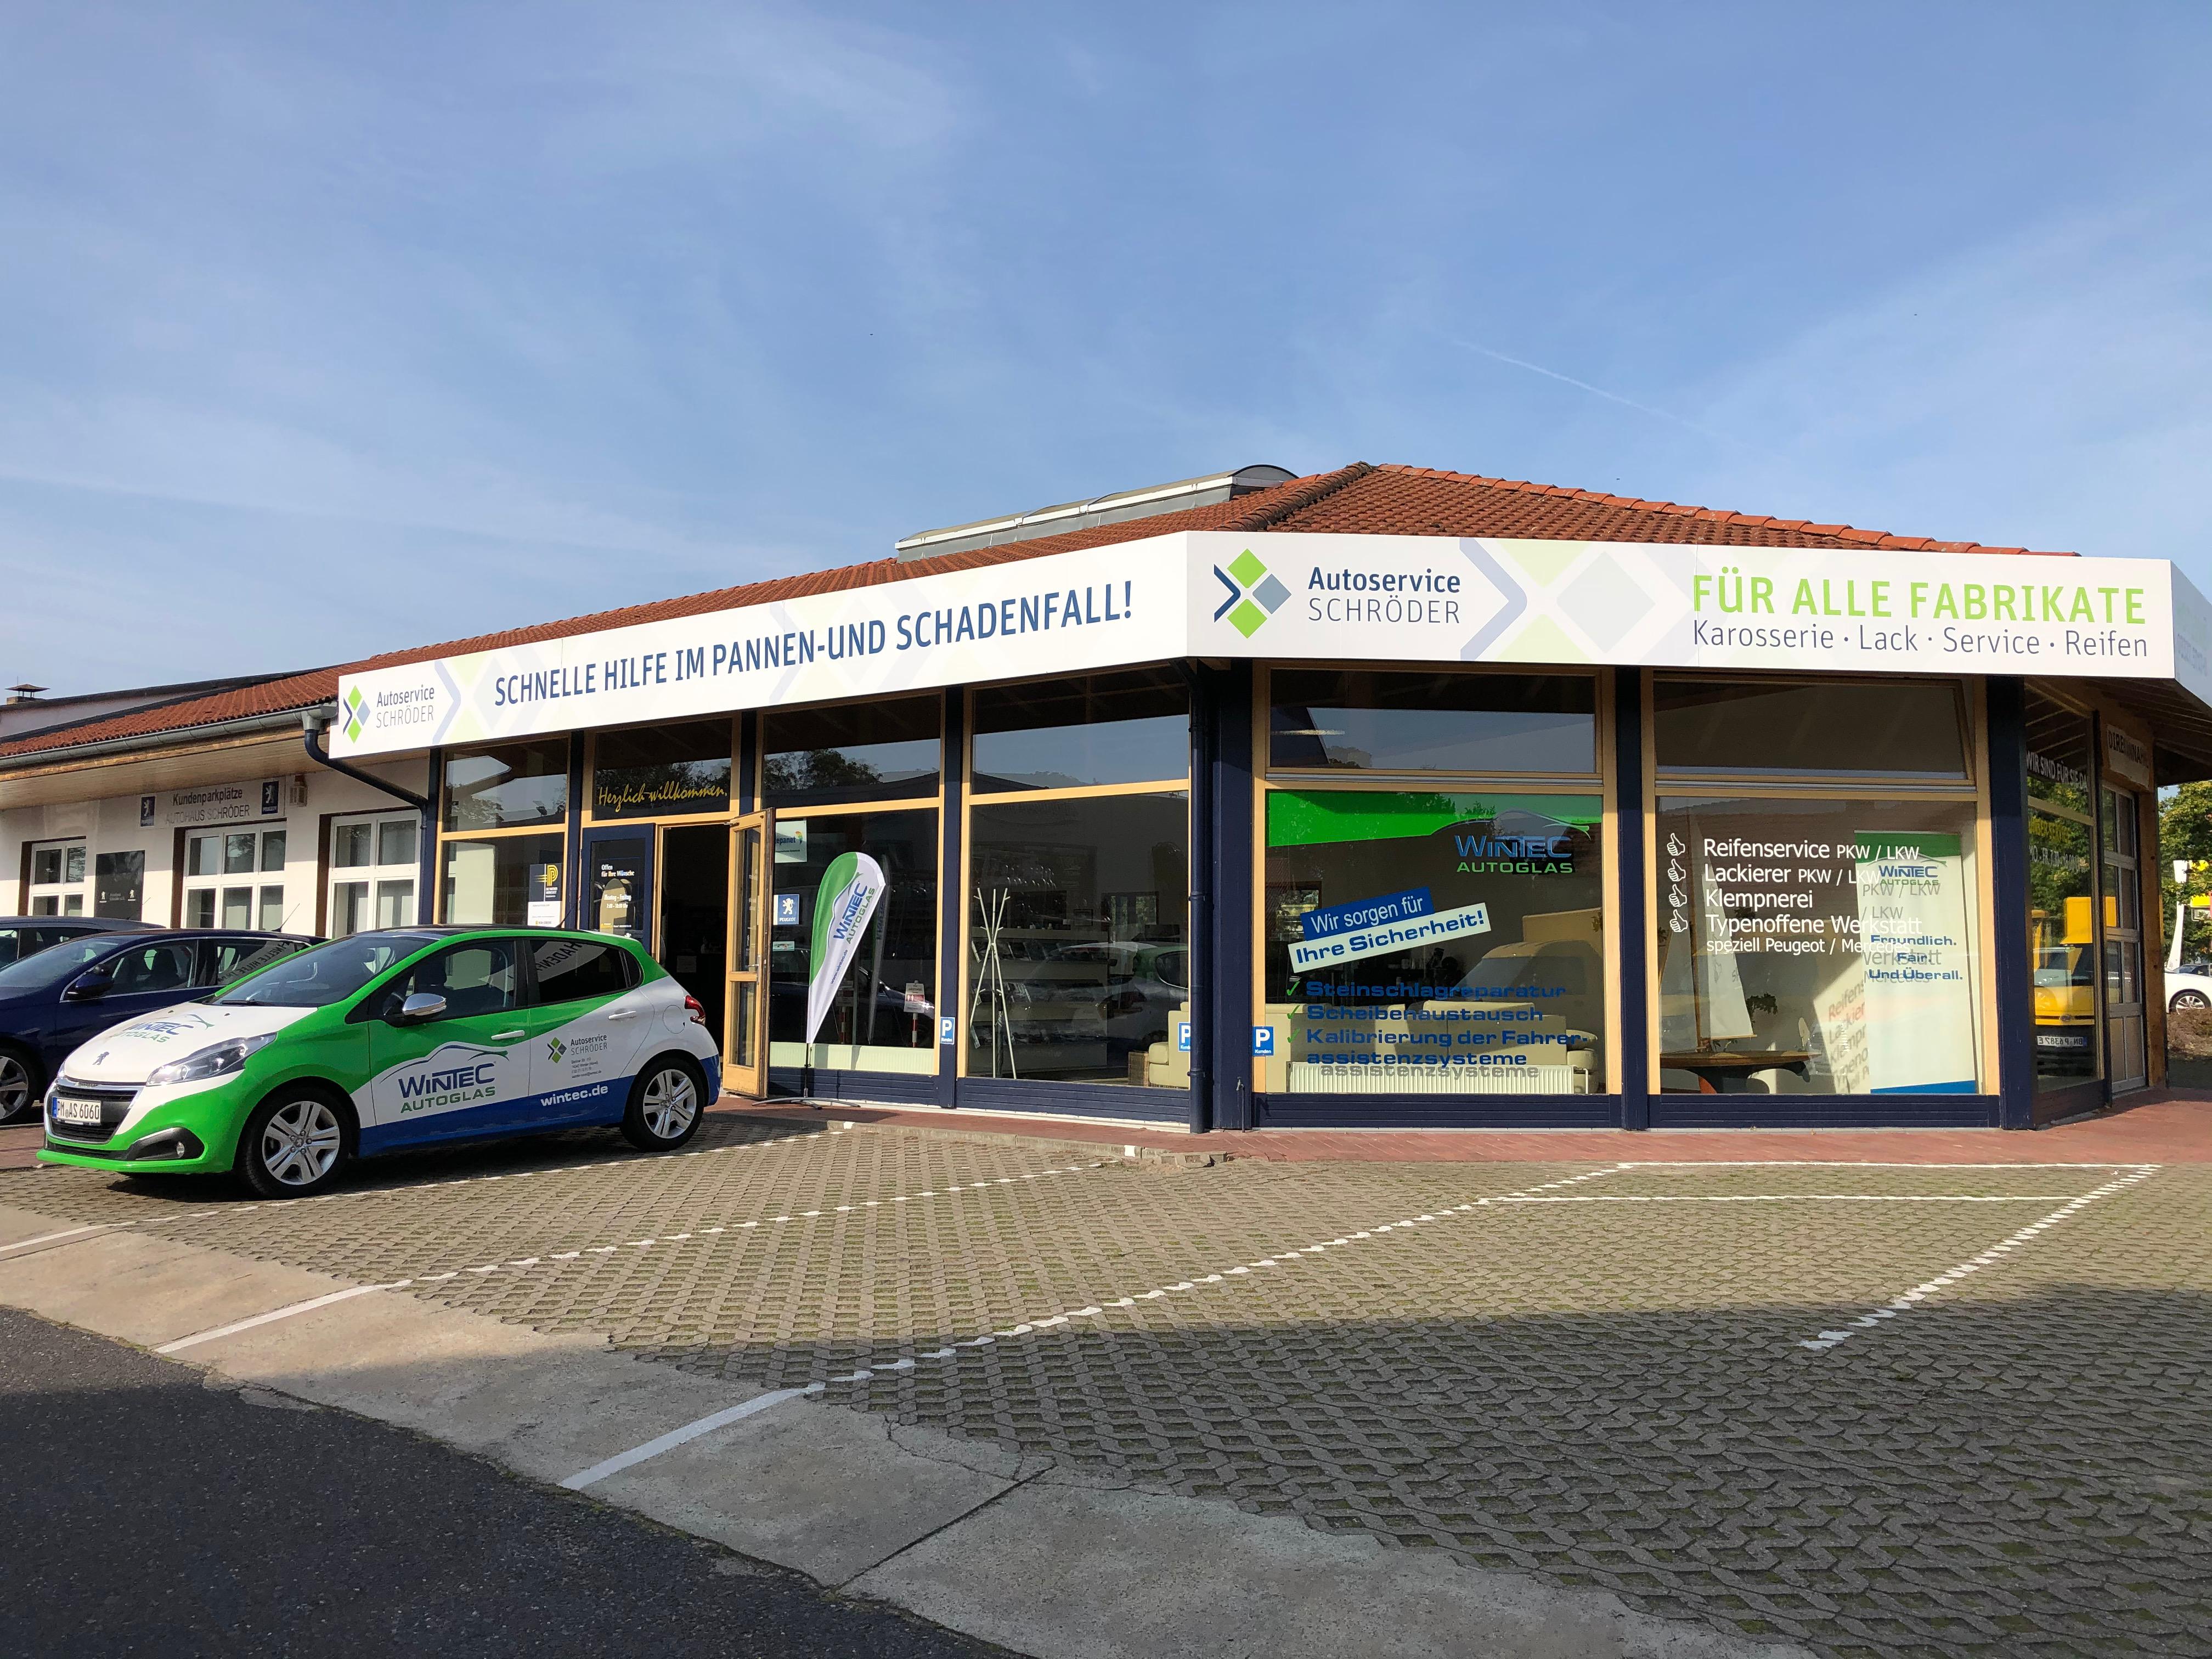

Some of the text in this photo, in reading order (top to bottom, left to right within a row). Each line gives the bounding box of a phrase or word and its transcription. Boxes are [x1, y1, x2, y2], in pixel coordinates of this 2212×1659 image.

[1307, 566, 1461, 593] Autoservice
[1694, 566, 2146, 624] FÜR ALLE FABRIKATE
[1308, 595, 1460, 624] SCHRÖDER
[495, 663, 596, 707] SCHNELLE
[604, 652, 667, 691] HILFE
[675, 646, 705, 681] IM
[896, 580, 1132, 651] SCHADENFALL!
[1694, 619, 1833, 649] Karosserie
[1860, 624, 1918, 651] Lack
[1943, 627, 2040, 654] Service
[2066, 630, 2147, 657] Reifen
[376, 684, 435, 708] Autoservice
[376, 705, 434, 729] SCHRÖDER
[2040, 755, 2056, 779] SIND
[173, 787, 243, 806] Kundenparkplätze
[599, 781, 727, 812] Herzlich willkommen.
[207, 804, 250, 820] SCHRÖDER
[776, 837, 796, 845] epanet
[1704, 838, 1830, 859] Reifenservice
[1837, 844, 1870, 859] PKW
[1887, 846, 1919, 860] LKW
[1457, 862, 1573, 873] AUTOGLAS
[1705, 863, 1792, 883] Lackierer
[1798, 868, 1832, 883] PKW
[1849, 870, 1881, 884] LKW
[1706, 888, 1813, 912] Klempnerei
[846, 887, 875, 944] AUTOGLAS
[1311, 896, 1423, 934] Wir sorgen für
[1705, 913, 1923, 936] Typenoffene Werkstatt
[1296, 910, 1485, 963] Ihre Sicherheit!
[1706, 937, 1759, 955] speziell
[1765, 938, 1825, 956] Peugeot
[1842, 939, 1911, 953] Mercedes
[1871, 935, 1957, 945] Freundlich.
[831, 949, 848, 984] www.wintec.de
[1897, 952, 1932, 962] Fair.
[1869, 967, 1963, 980] Und Überall.
[1306, 981, 1566, 1001] Steinschlagreparatur
[1307, 1005, 1543, 1022] Scheibenaustausch
[942, 1019, 952, 1036] P
[1256, 1029, 1270, 1047] P
[1306, 1029, 1588, 1047] Kalibrierung der Fahrer-
[571, 1034, 607, 1046] Autoservice
[1307, 1053, 1527, 1068] assistenzsysteme
[400, 1086, 495, 1113] AUTOGLAS
[540, 1085, 608, 1107] wintec.de
[79, 1103, 99, 1120] 6060
